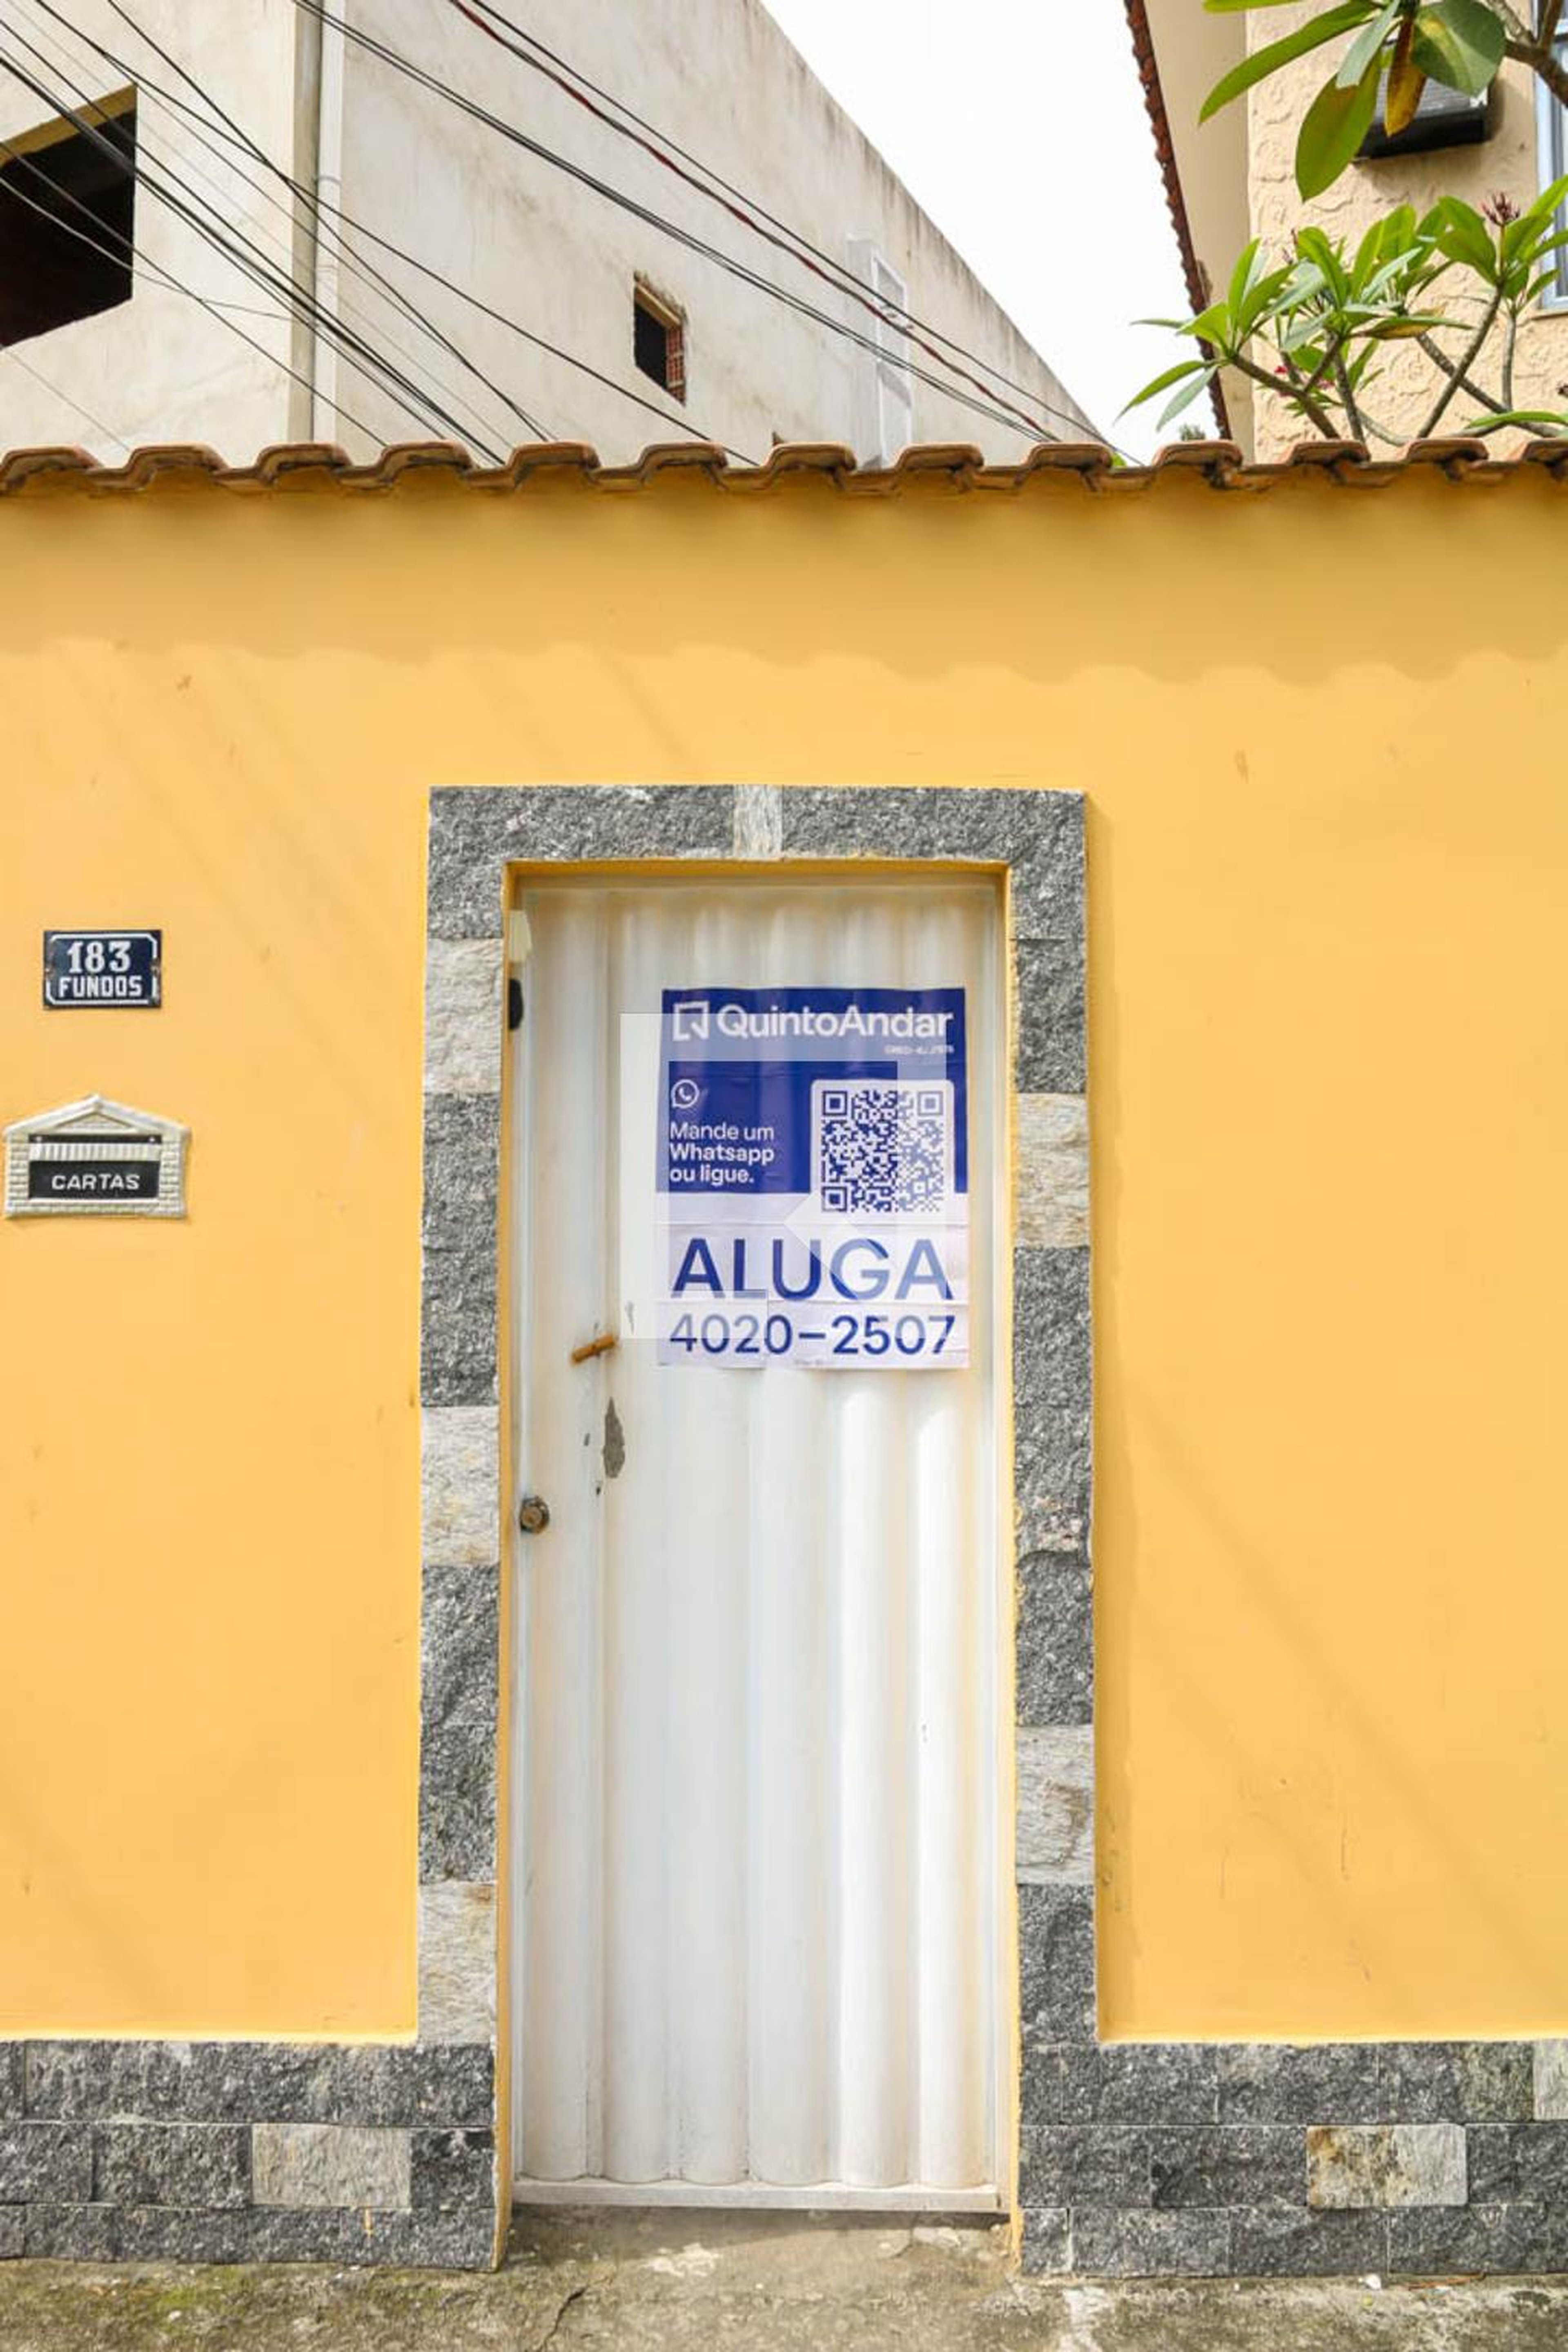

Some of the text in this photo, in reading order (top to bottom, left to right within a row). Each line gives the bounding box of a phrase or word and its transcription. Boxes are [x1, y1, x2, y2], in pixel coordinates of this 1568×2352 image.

[67, 941, 131, 973] 183
[59, 976, 142, 998] FUNDOS
[717, 1004, 953, 1039] QuintoAndar
[670, 1122, 774, 1141] Mande um
[670, 1143, 775, 1164] Whatsapp
[52, 1174, 140, 1191] CARTAS
[670, 1164, 754, 1185] ou ligue.
[671, 1238, 953, 1300] ALUGA
[670, 1314, 955, 1354] 4020-2507
